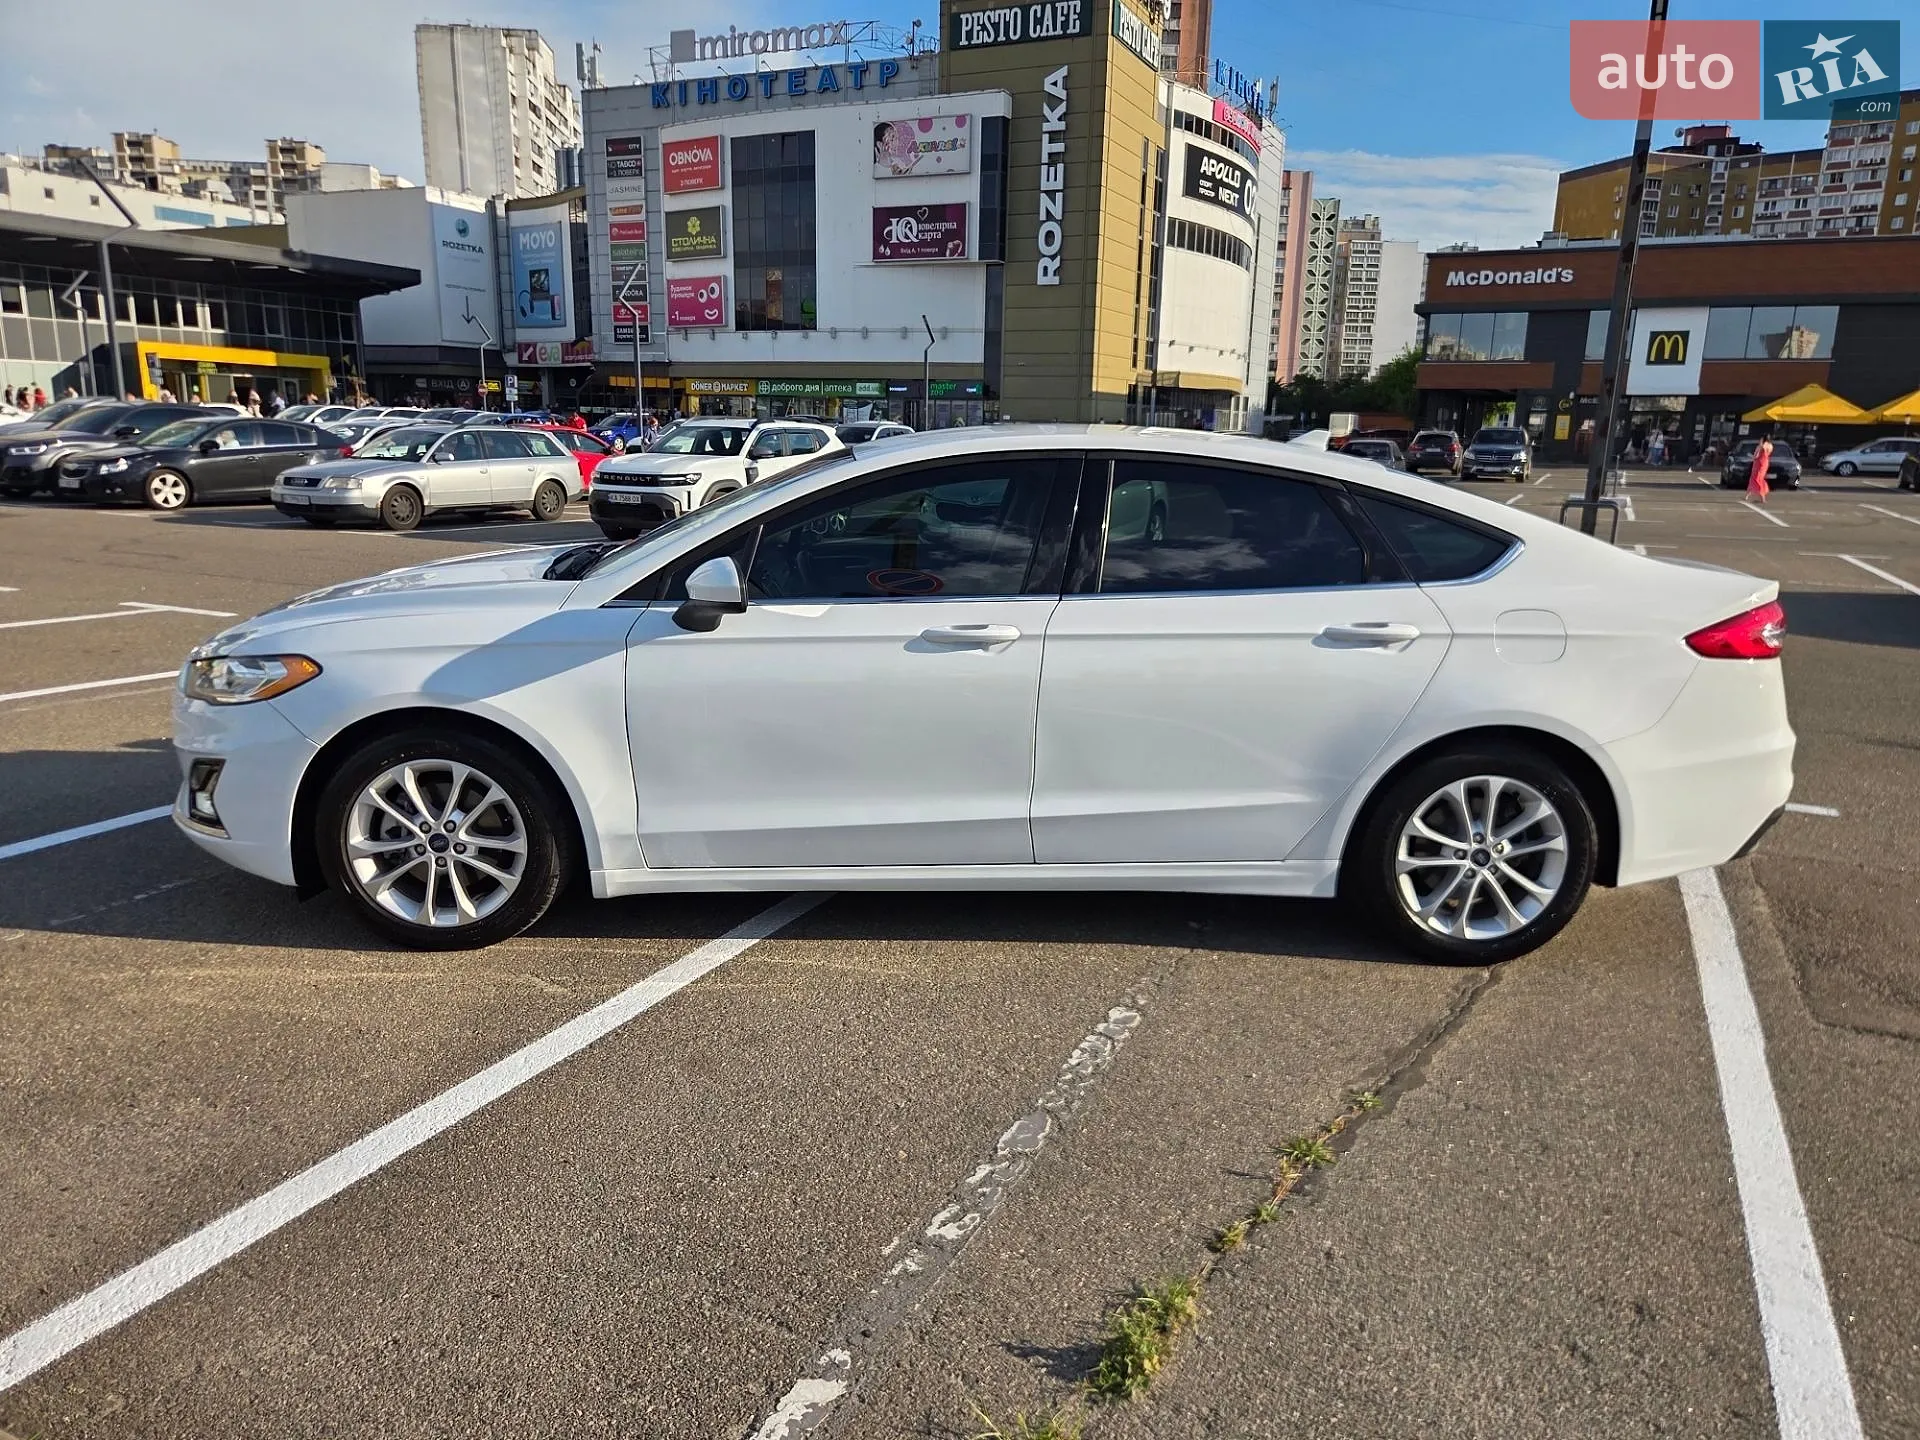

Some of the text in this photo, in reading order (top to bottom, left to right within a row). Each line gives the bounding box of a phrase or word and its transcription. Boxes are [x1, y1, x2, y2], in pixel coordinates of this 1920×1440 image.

[959, 0, 1081, 46] PESTO CAFE
[699, 20, 847, 59] miromax
[1119, 3, 1141, 53] PESTO
[1141, 24, 1160, 69] CAFE
[651, 60, 899, 108] КІНОТЕАТР
[1037, 65, 1068, 285] ROZETKA
[1200, 156, 1241, 188] APOLLO
[608, 185, 641, 194] JASMINE
[1218, 186, 1240, 207] NEXT
[519, 230, 555, 250] MOYO
[672, 236, 716, 247] СТОЛИЧНА
[919, 231, 941, 241] карта
[442, 240, 484, 254] ROZETKA
[1446, 267, 1574, 286] McDonald's
[431, 379, 454, 389] ВХІД
[507, 376, 514, 385] P
[691, 381, 748, 392] DÖNER МАРКЕТ
[772, 382, 852, 393] доброго дня аптека
[930, 382, 957, 390] master
